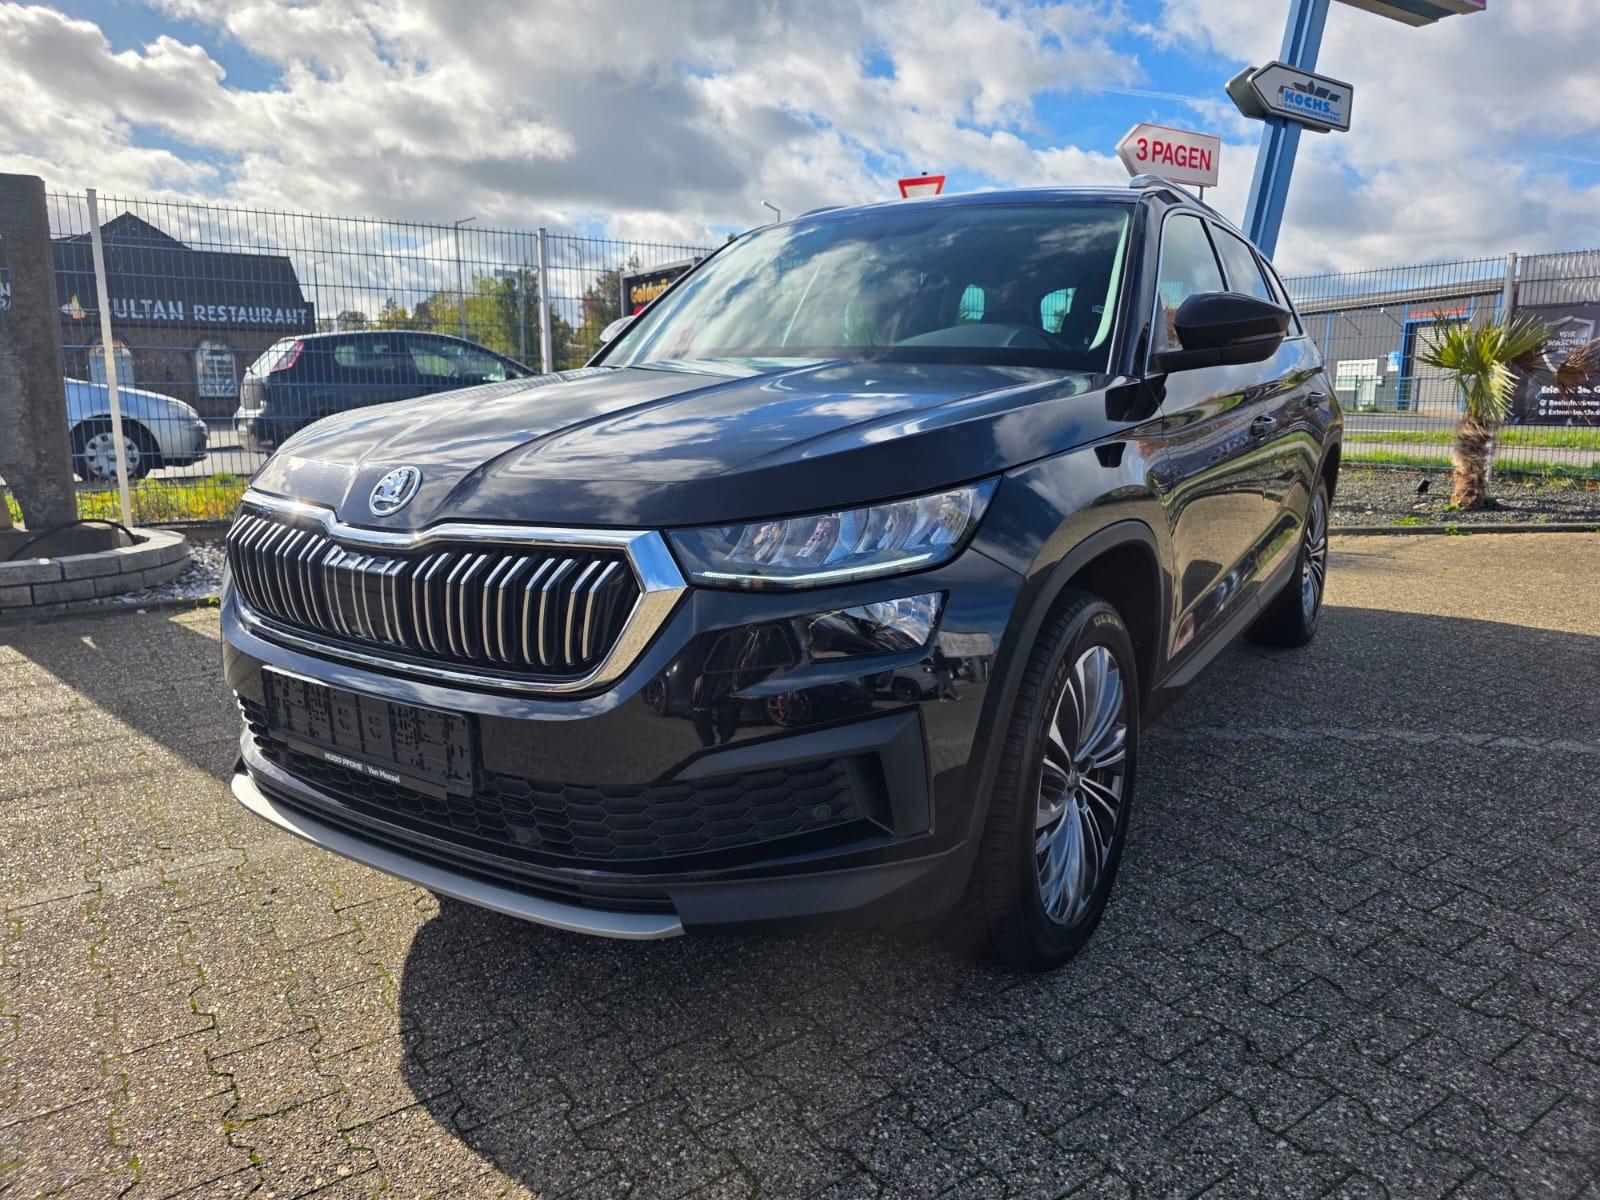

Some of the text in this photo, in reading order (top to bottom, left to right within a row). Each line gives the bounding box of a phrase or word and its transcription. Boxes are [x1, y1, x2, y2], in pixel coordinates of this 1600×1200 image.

[1136, 138, 1212, 172] 3 PAGEN
[109, 298, 307, 325] ULTAN RESTAURANT
[367, 765, 380, 777] Van
